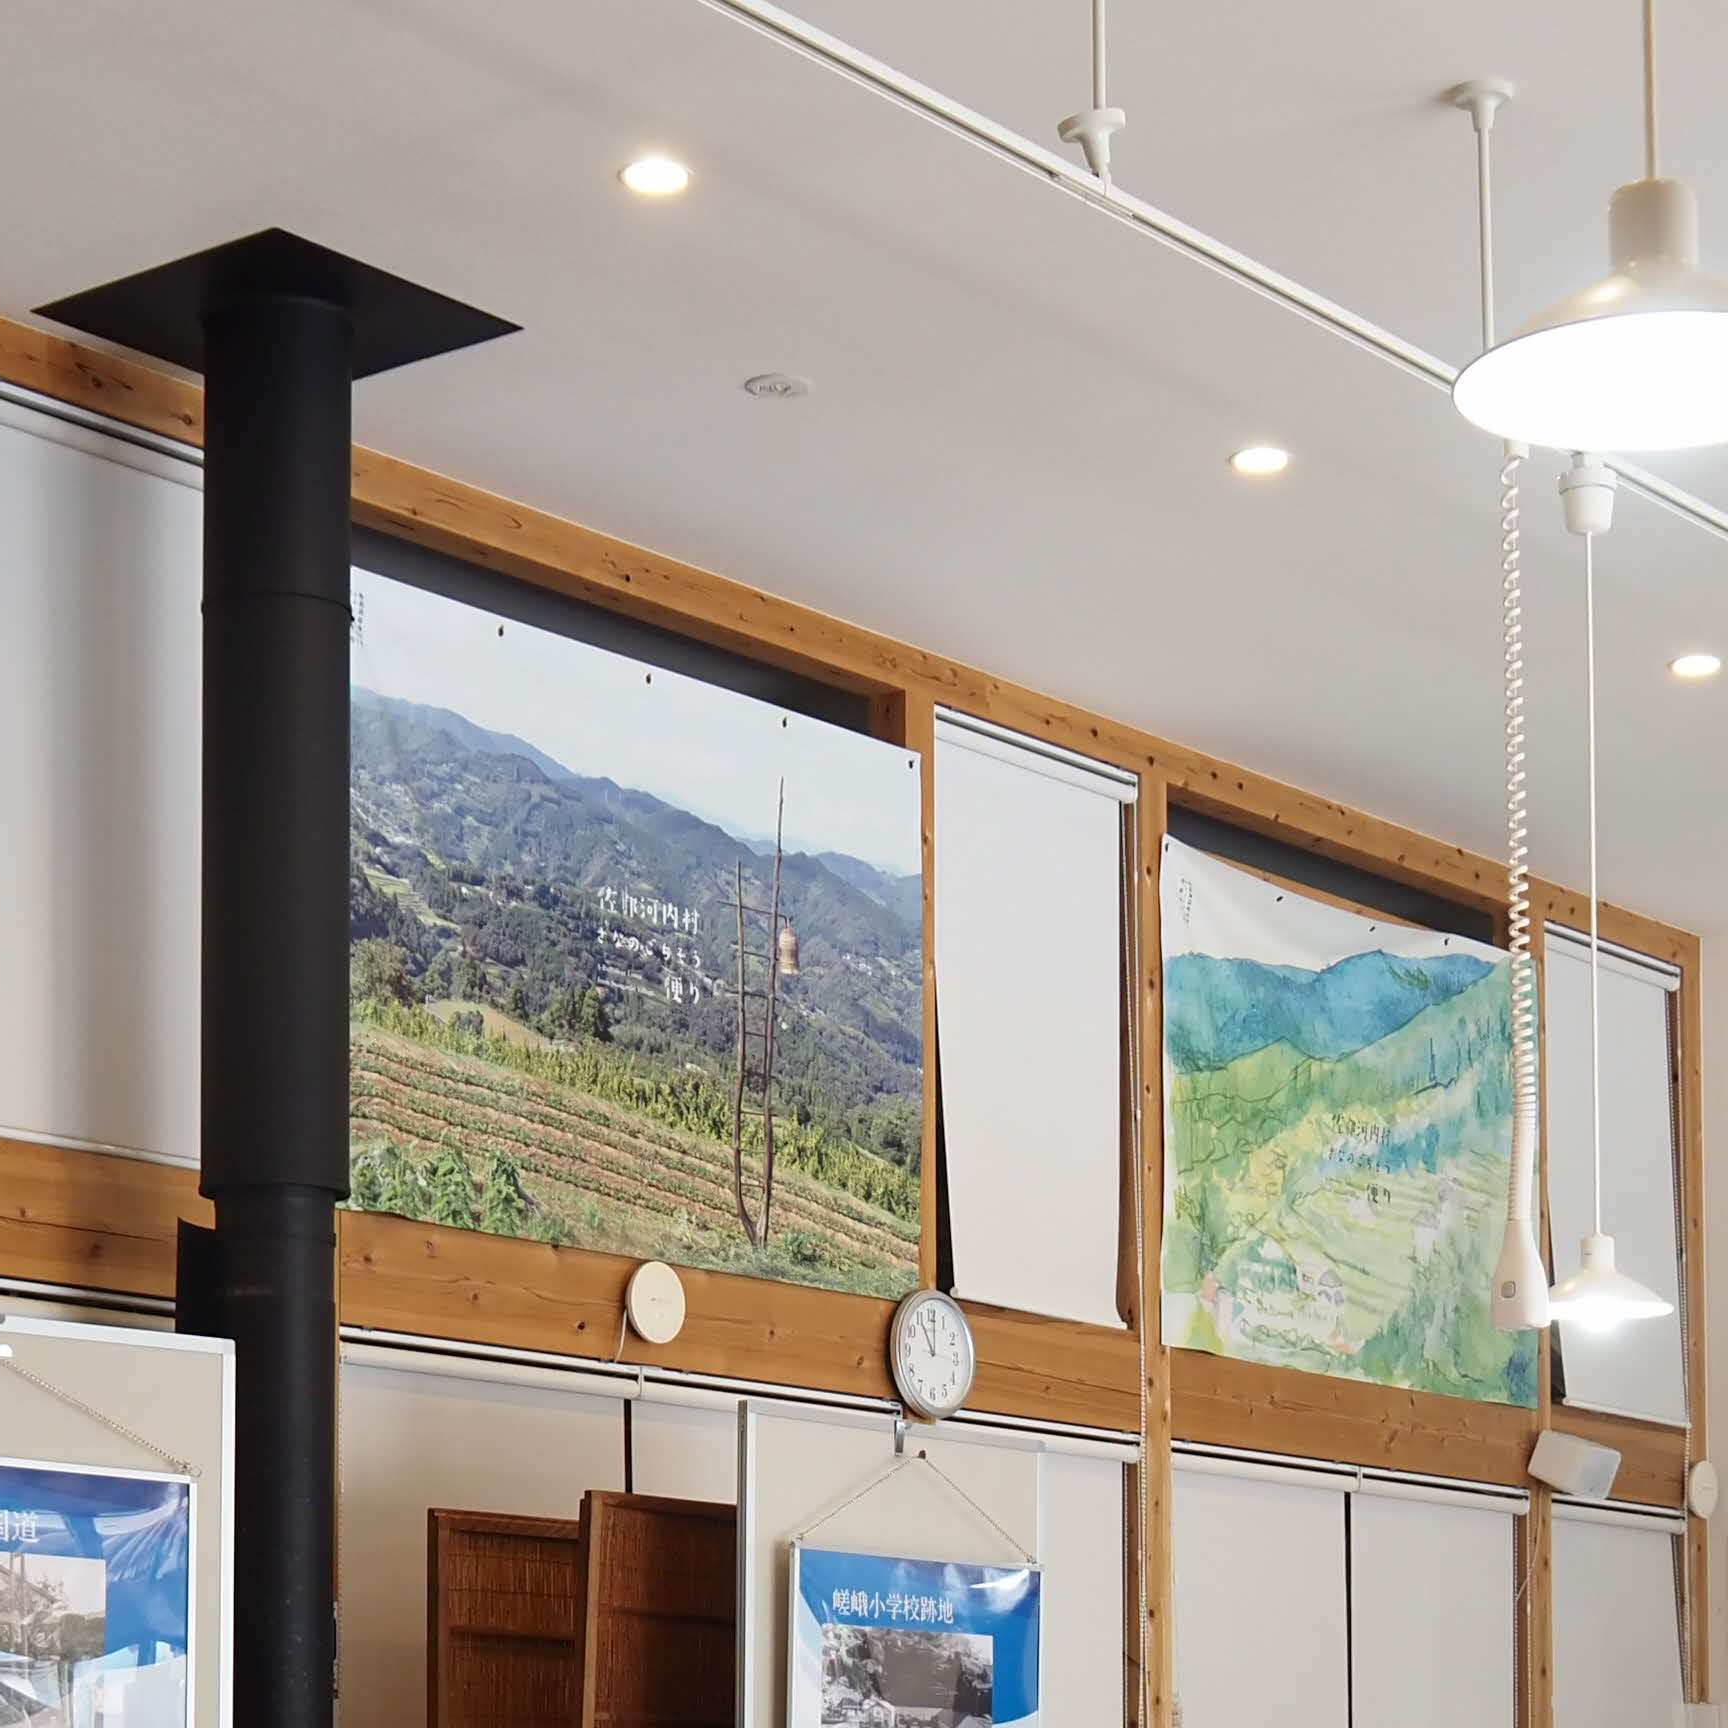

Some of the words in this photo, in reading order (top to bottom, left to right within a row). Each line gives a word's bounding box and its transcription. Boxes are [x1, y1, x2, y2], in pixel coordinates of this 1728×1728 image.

[597, 886, 700, 935] 佐那河内村
[664, 974, 700, 1005] 便り
[832, 1588, 954, 1624] 嵯峨小学校跡地
